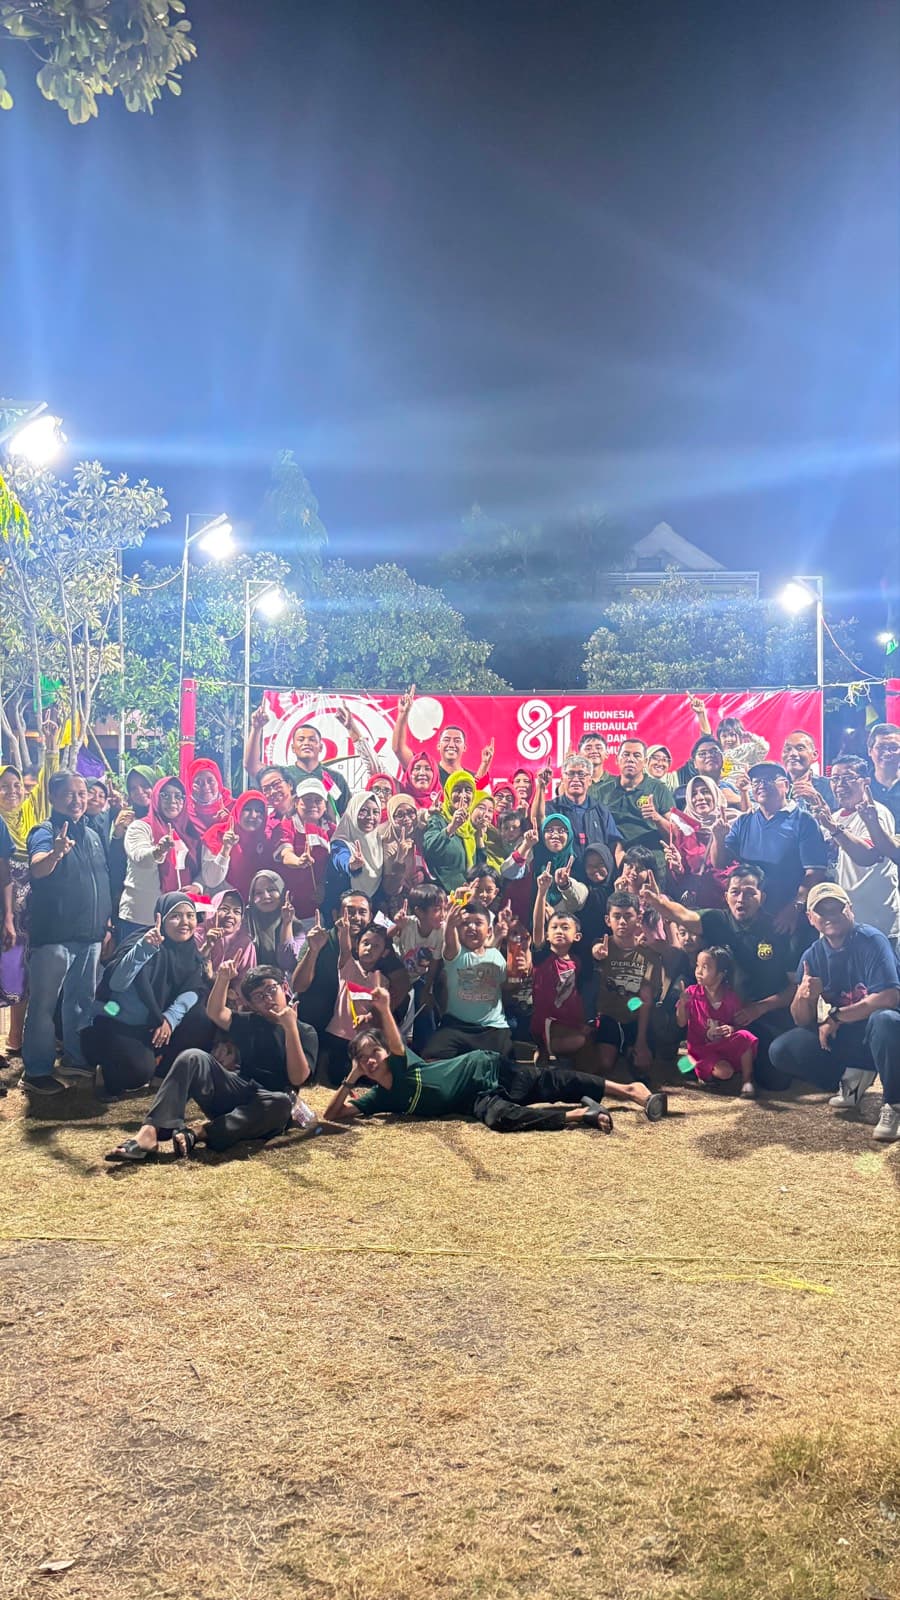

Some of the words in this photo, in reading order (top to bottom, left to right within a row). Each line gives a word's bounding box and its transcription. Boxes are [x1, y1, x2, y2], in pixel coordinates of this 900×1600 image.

[583, 710, 635, 719] INDONESIA
[583, 722, 639, 731] BERDAULAT
[517, 699, 577, 768] 81
[607, 734, 627, 743] DAN
